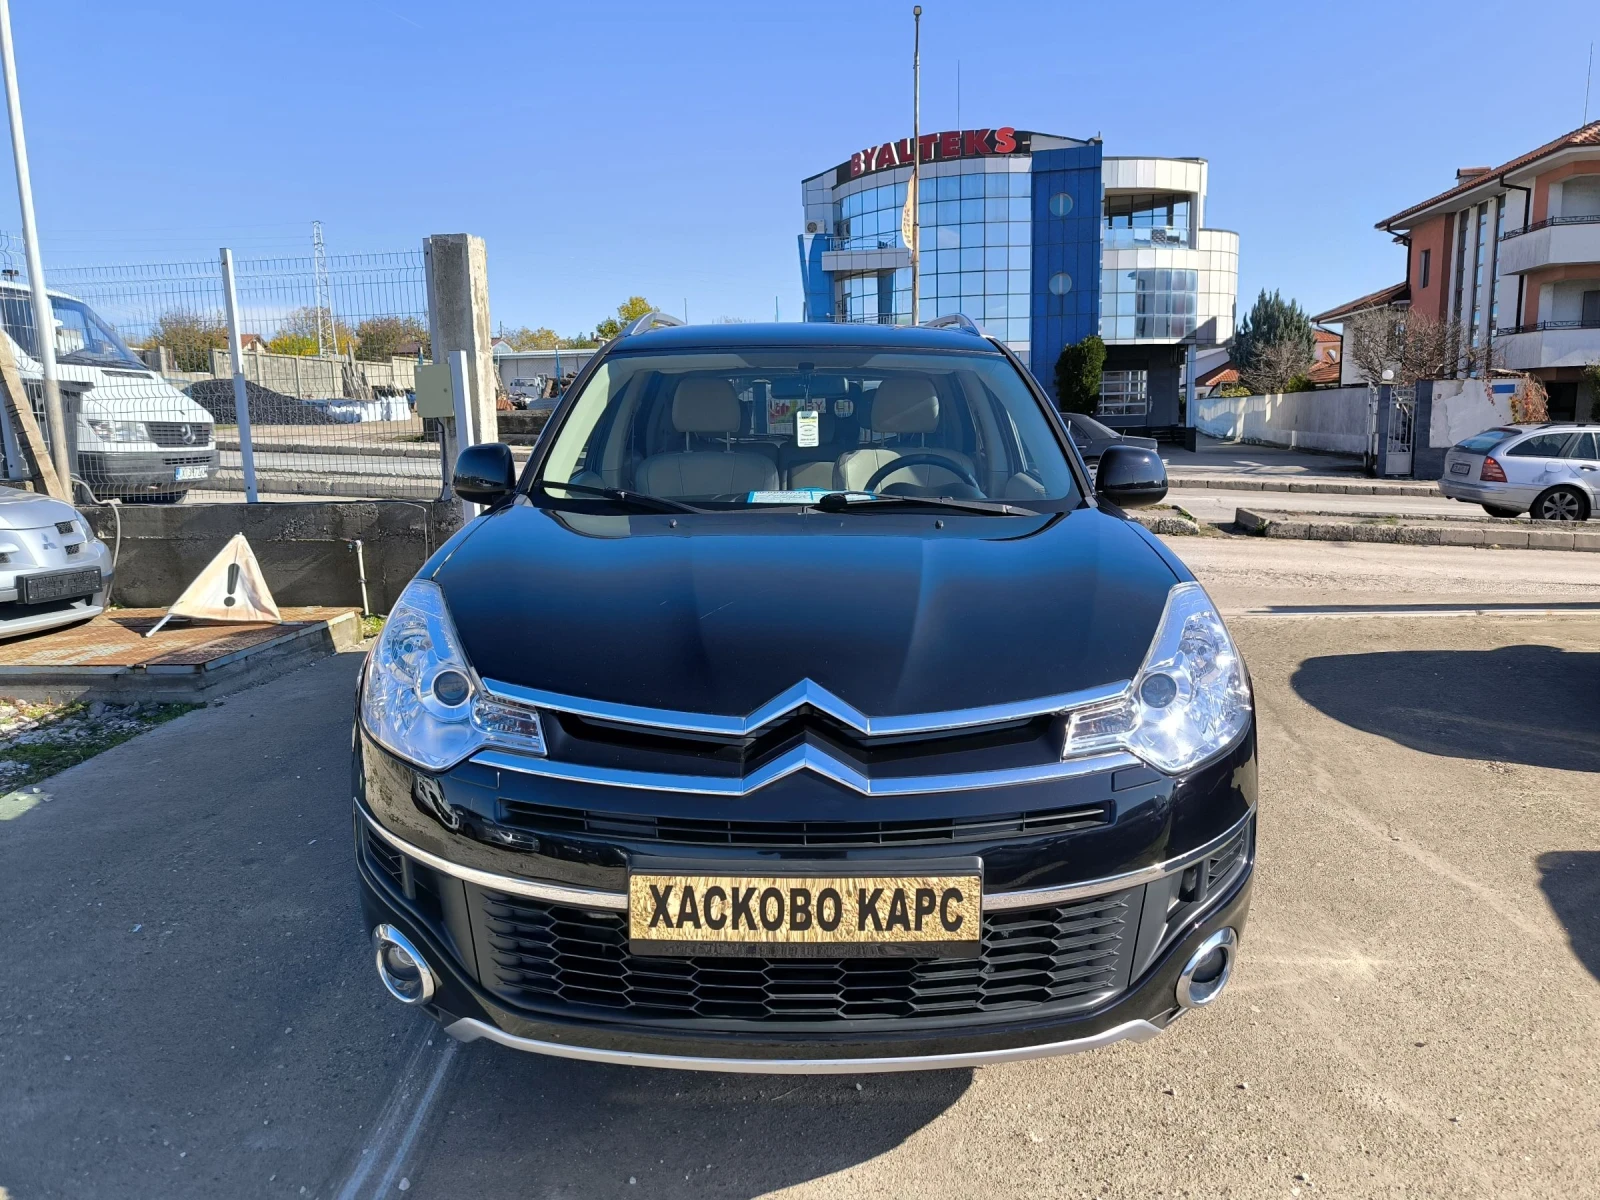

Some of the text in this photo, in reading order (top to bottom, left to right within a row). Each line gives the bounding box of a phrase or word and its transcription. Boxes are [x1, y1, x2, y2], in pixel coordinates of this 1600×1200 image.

[850, 127, 1017, 178] BYALTEKS
[649, 884, 965, 932] ХАСКОВО КАРС
